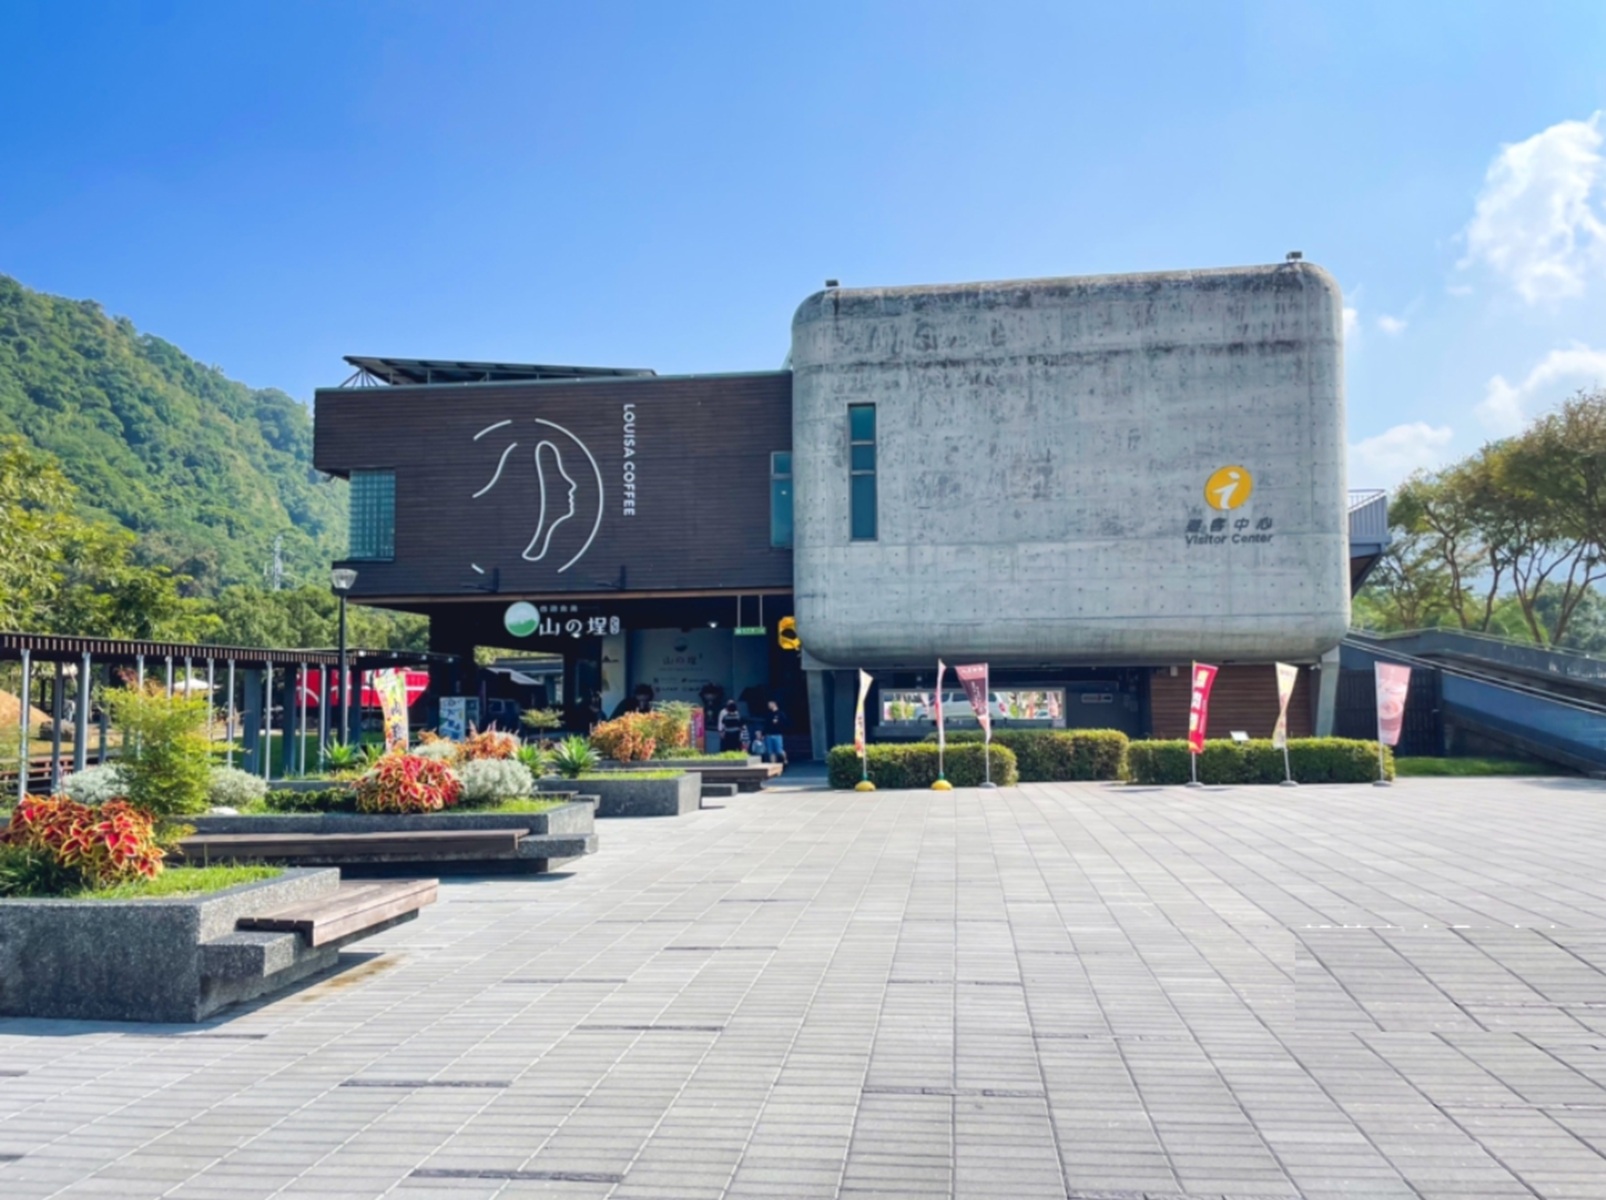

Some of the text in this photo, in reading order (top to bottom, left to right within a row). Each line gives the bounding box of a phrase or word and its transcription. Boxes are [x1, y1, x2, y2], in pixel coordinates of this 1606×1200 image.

[623, 404, 636, 516] LOUISA COFFEE
[1185, 533, 1274, 545] Visitor Center
